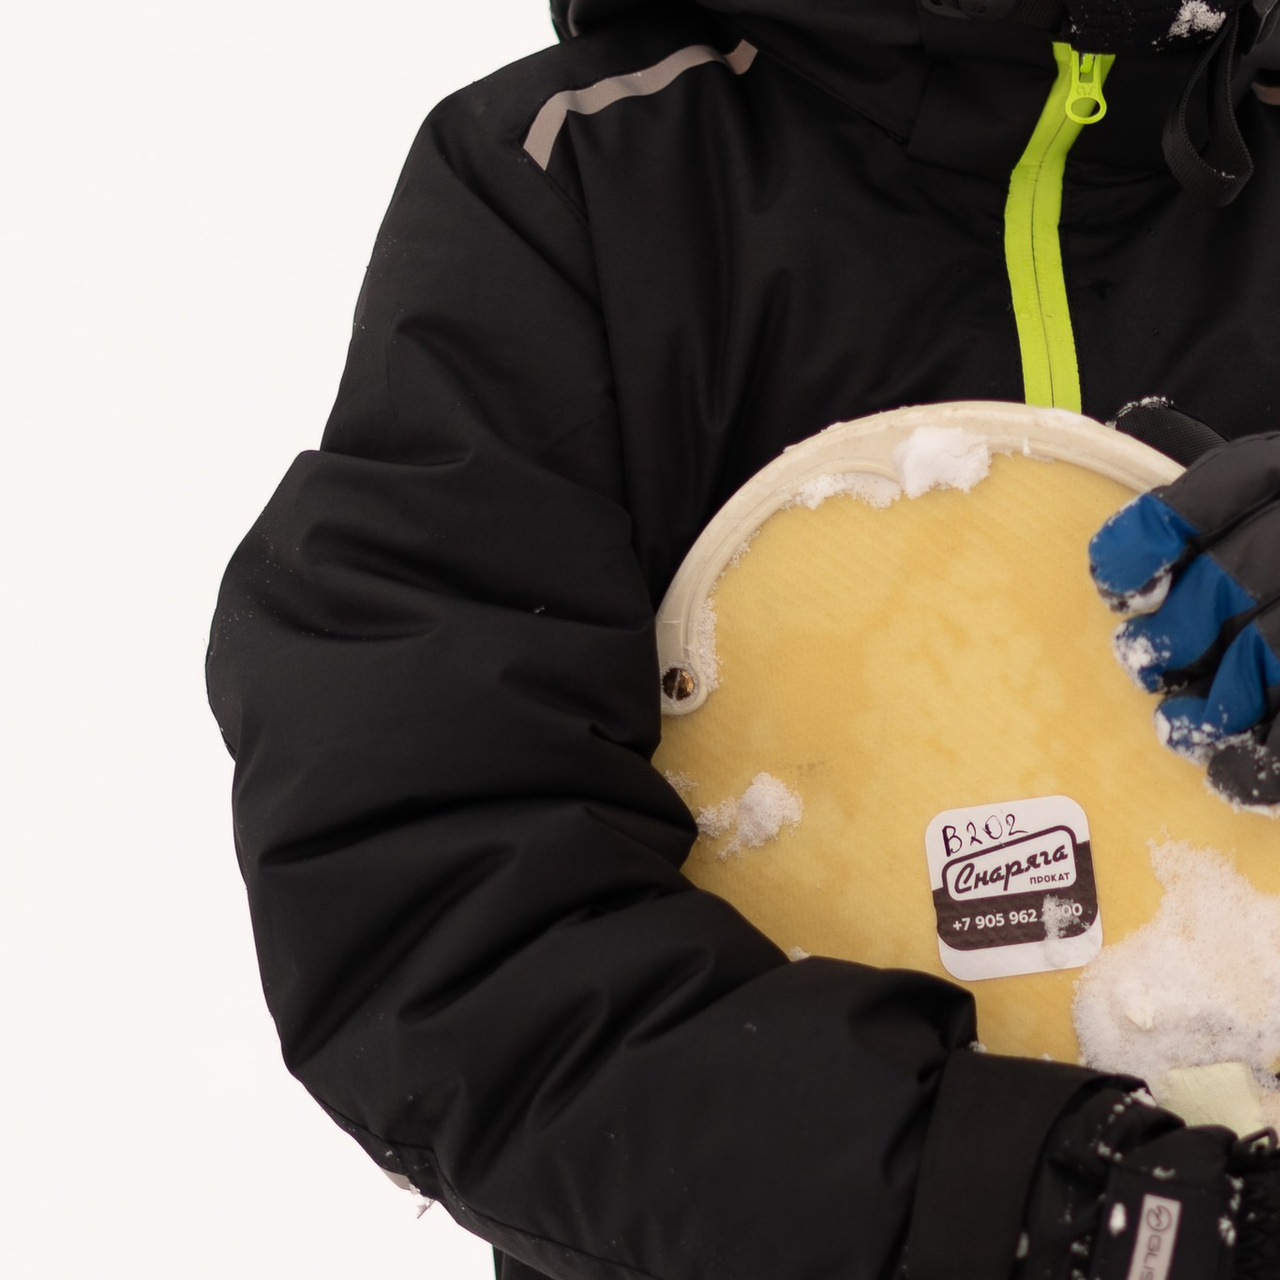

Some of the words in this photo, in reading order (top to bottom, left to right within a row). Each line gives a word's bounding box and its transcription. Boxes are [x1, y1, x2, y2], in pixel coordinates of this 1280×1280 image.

[955, 845, 1068, 894] Снаряга
[1030, 872, 1070, 885] ПРОКАТ
[953, 918, 971, 931] +7
[975, 913, 1005, 929] 905
[1009, 909, 1038, 924] 962
